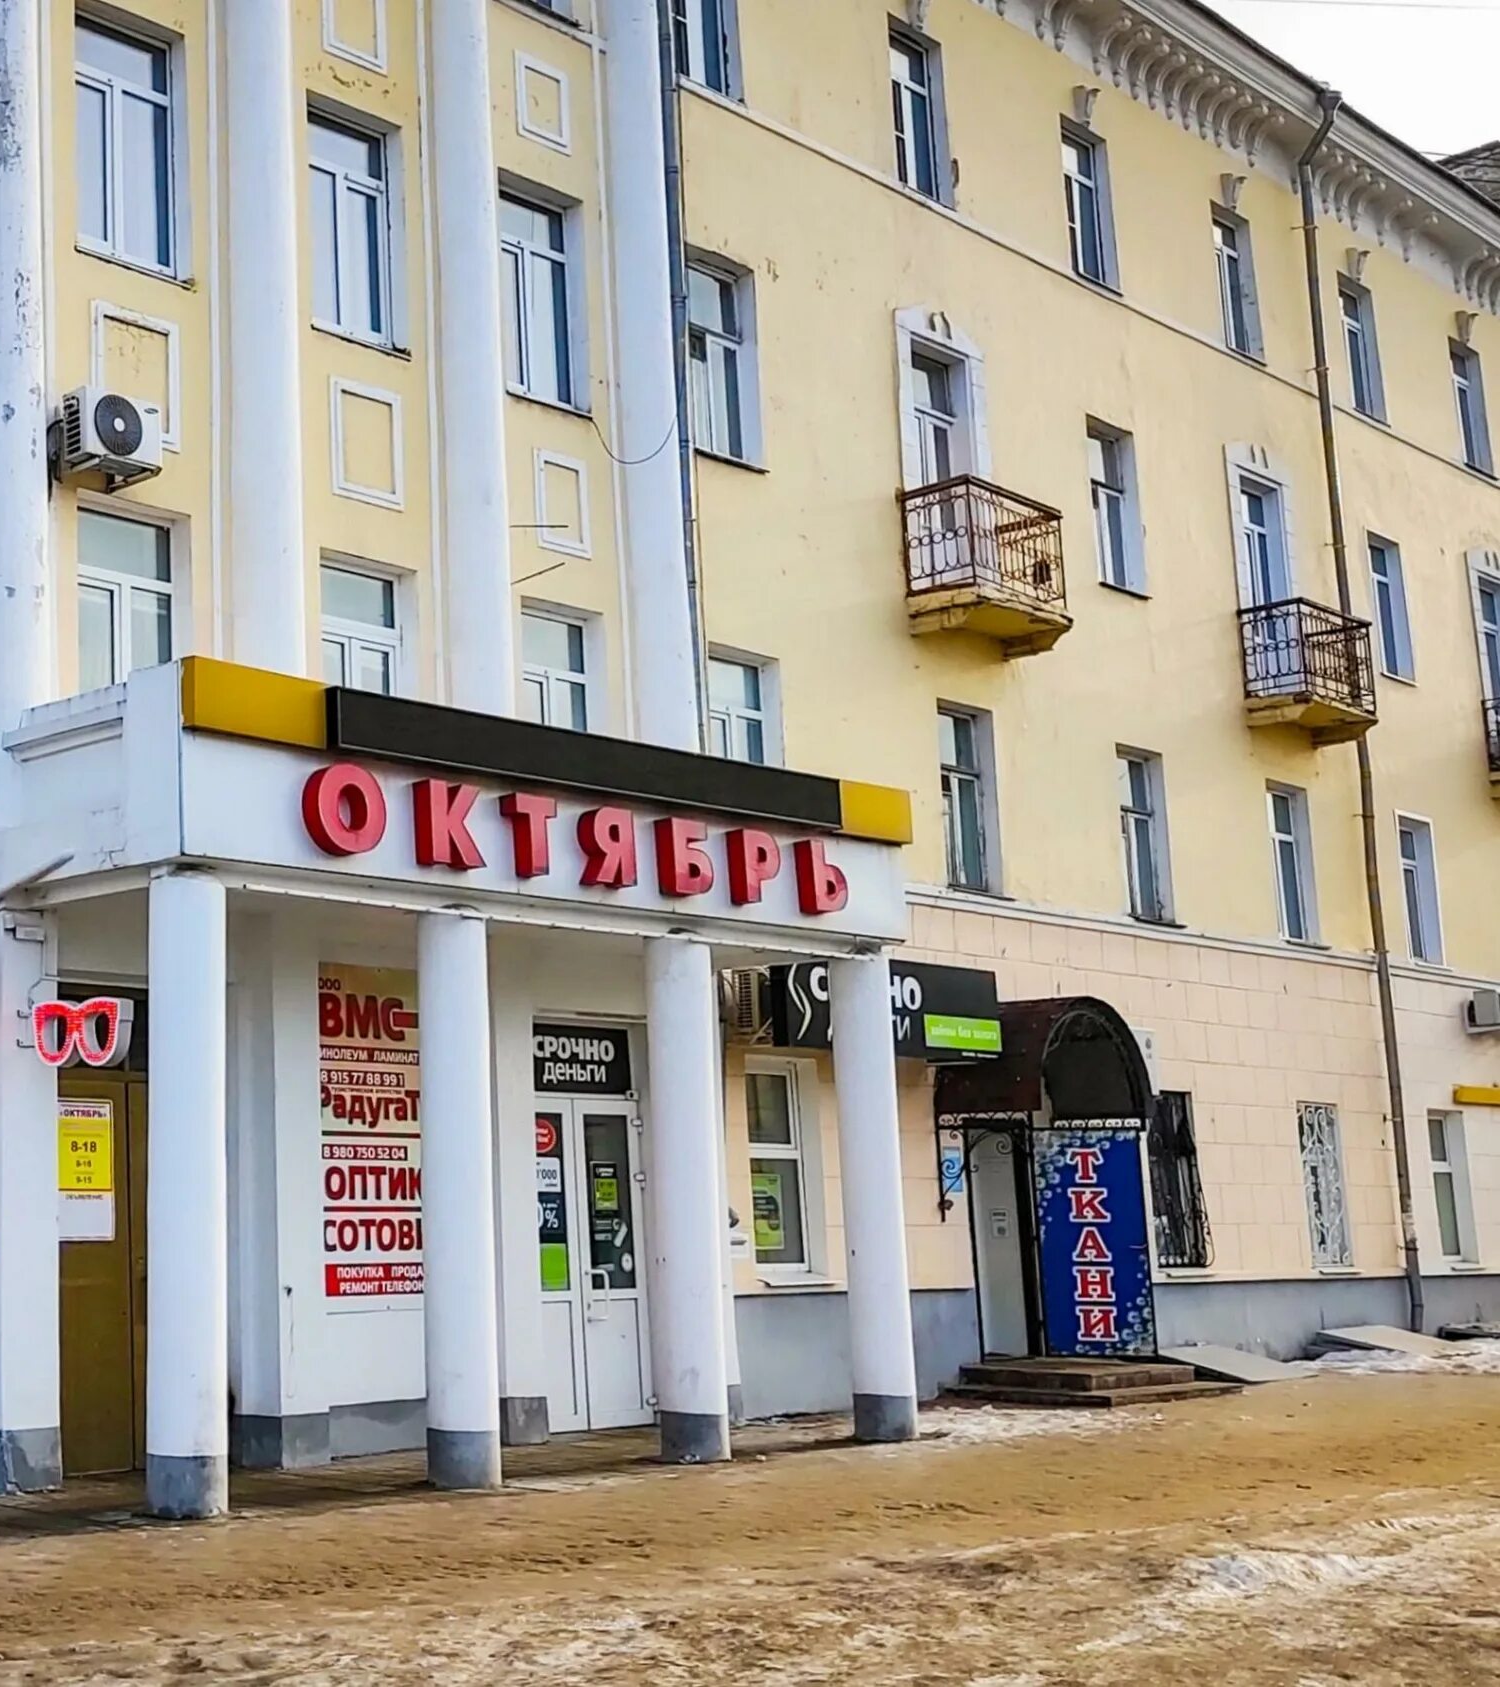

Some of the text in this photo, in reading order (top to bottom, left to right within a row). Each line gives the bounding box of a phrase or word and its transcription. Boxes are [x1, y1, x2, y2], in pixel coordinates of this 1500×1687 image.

[301, 762, 850, 915] ОКТЯБРЬ
[810, 966, 922, 1011] СНО
[532, 1034, 615, 1063] СРОЧНО
[70, 1140, 97, 1153] 8-18
[323, 1145, 331, 1158] 8
[1066, 1147, 1119, 1343] ТКАНИ
[336, 1266, 384, 1279] ПОКУПКА
[339, 1281, 379, 1294] РЕМОНТ
